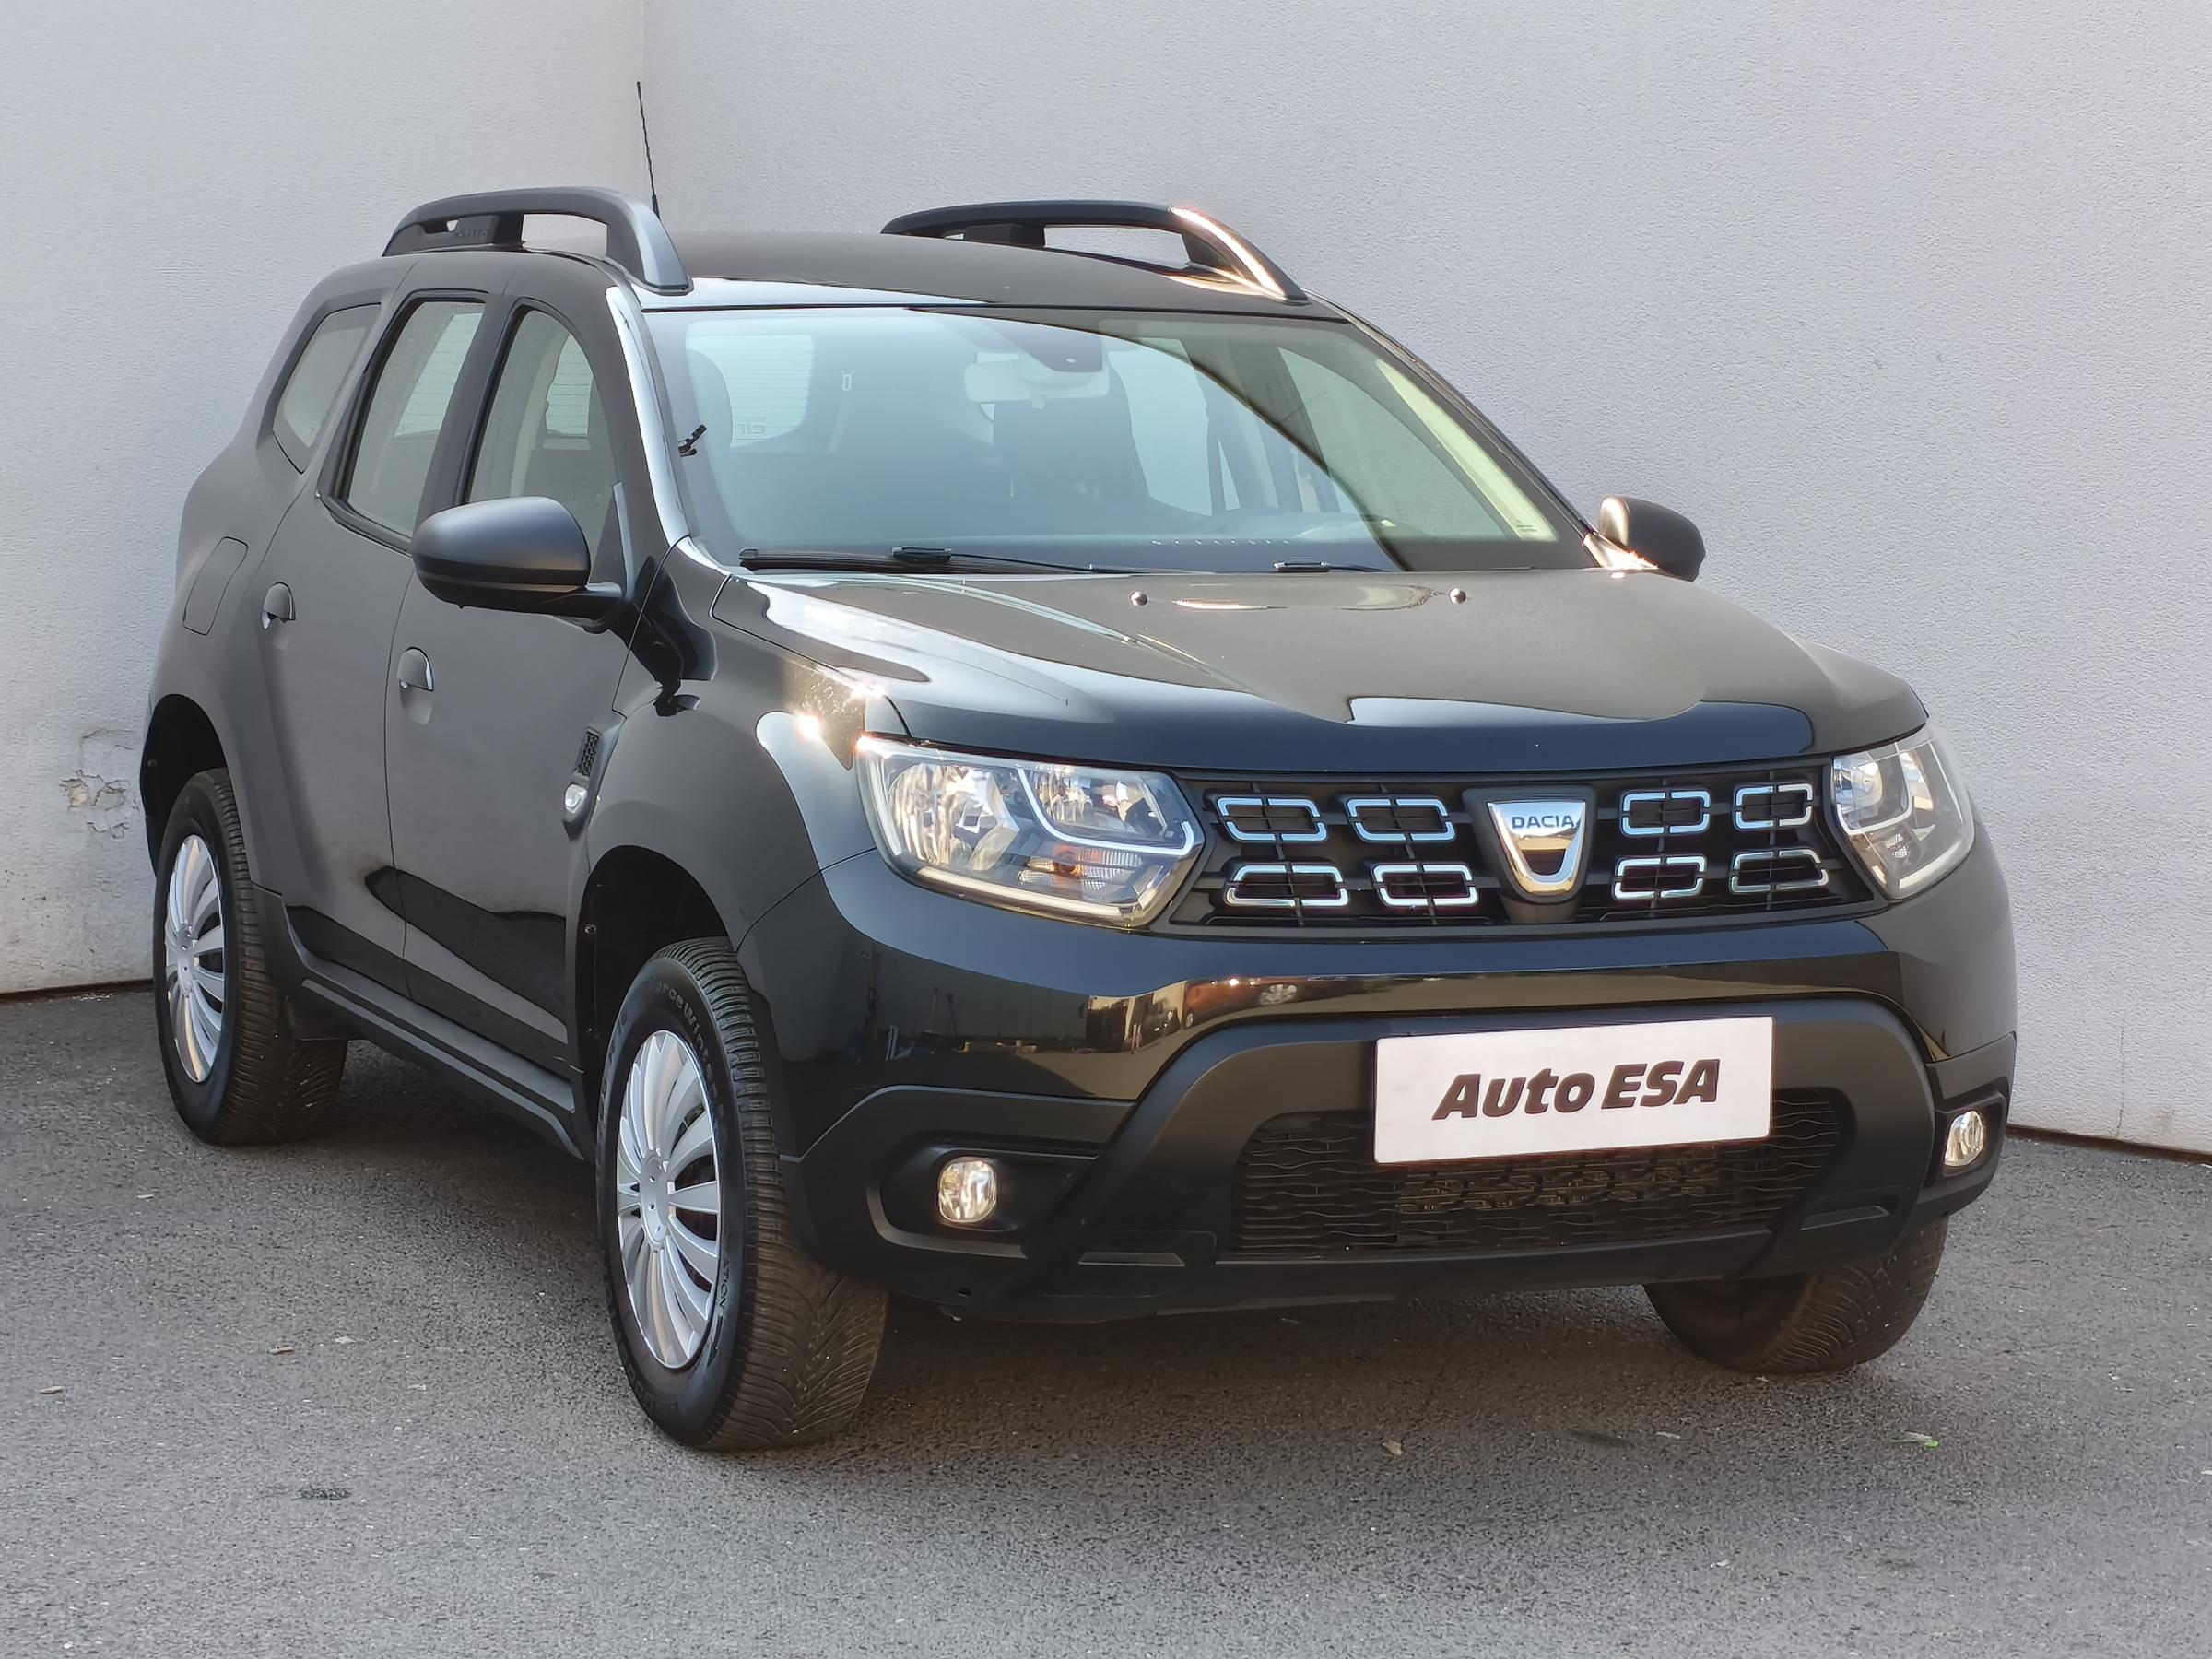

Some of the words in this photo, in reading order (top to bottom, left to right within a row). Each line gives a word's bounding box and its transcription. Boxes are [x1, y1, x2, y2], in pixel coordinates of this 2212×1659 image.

[1511, 815, 1575, 829] DACIA
[1431, 1067, 1595, 1121] Auto
[1601, 1058, 1721, 1110] ESA
